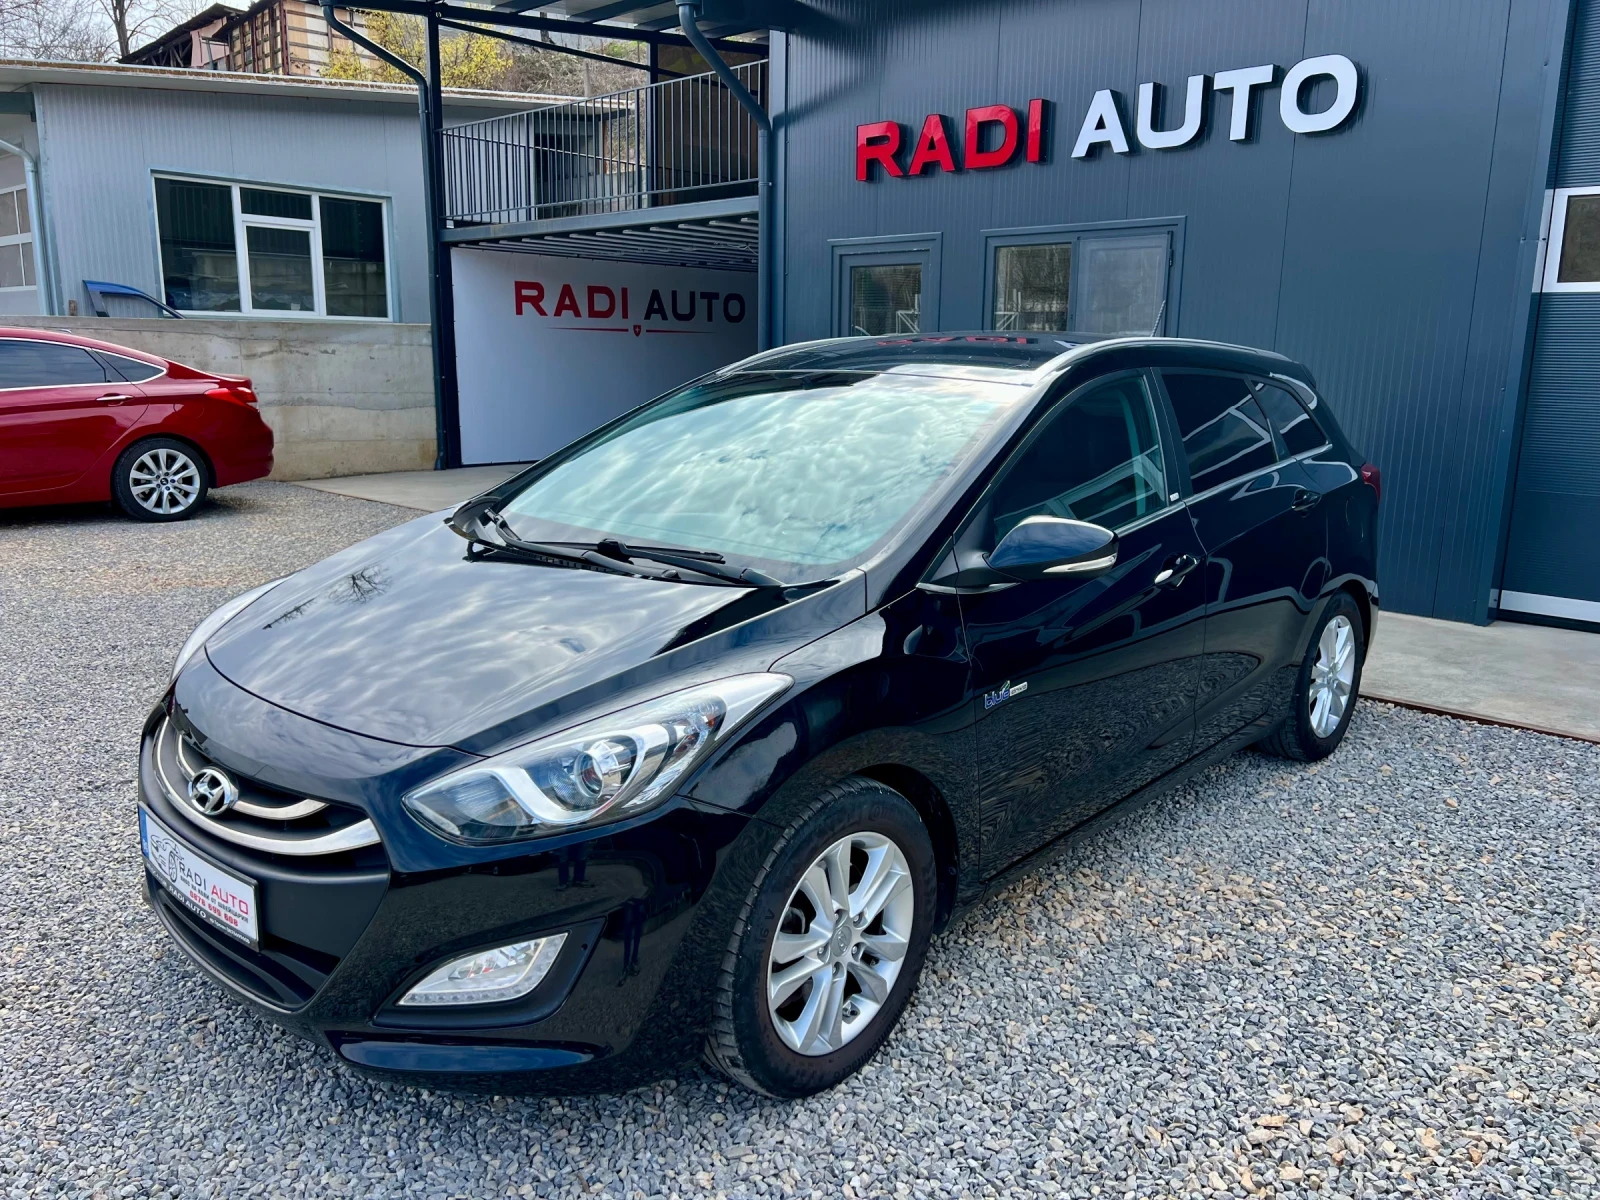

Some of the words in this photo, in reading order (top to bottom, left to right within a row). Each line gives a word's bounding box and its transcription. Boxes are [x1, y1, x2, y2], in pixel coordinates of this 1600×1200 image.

[856, 98, 1047, 181] RADI
[1071, 53, 1360, 158] AUTO
[514, 280, 629, 319] RADI
[643, 289, 746, 323] AUTO
[169, 885, 185, 903] RADI
[185, 900, 206, 918] AUTO
[179, 862, 206, 891] RADI
[211, 884, 249, 915] AUTO
